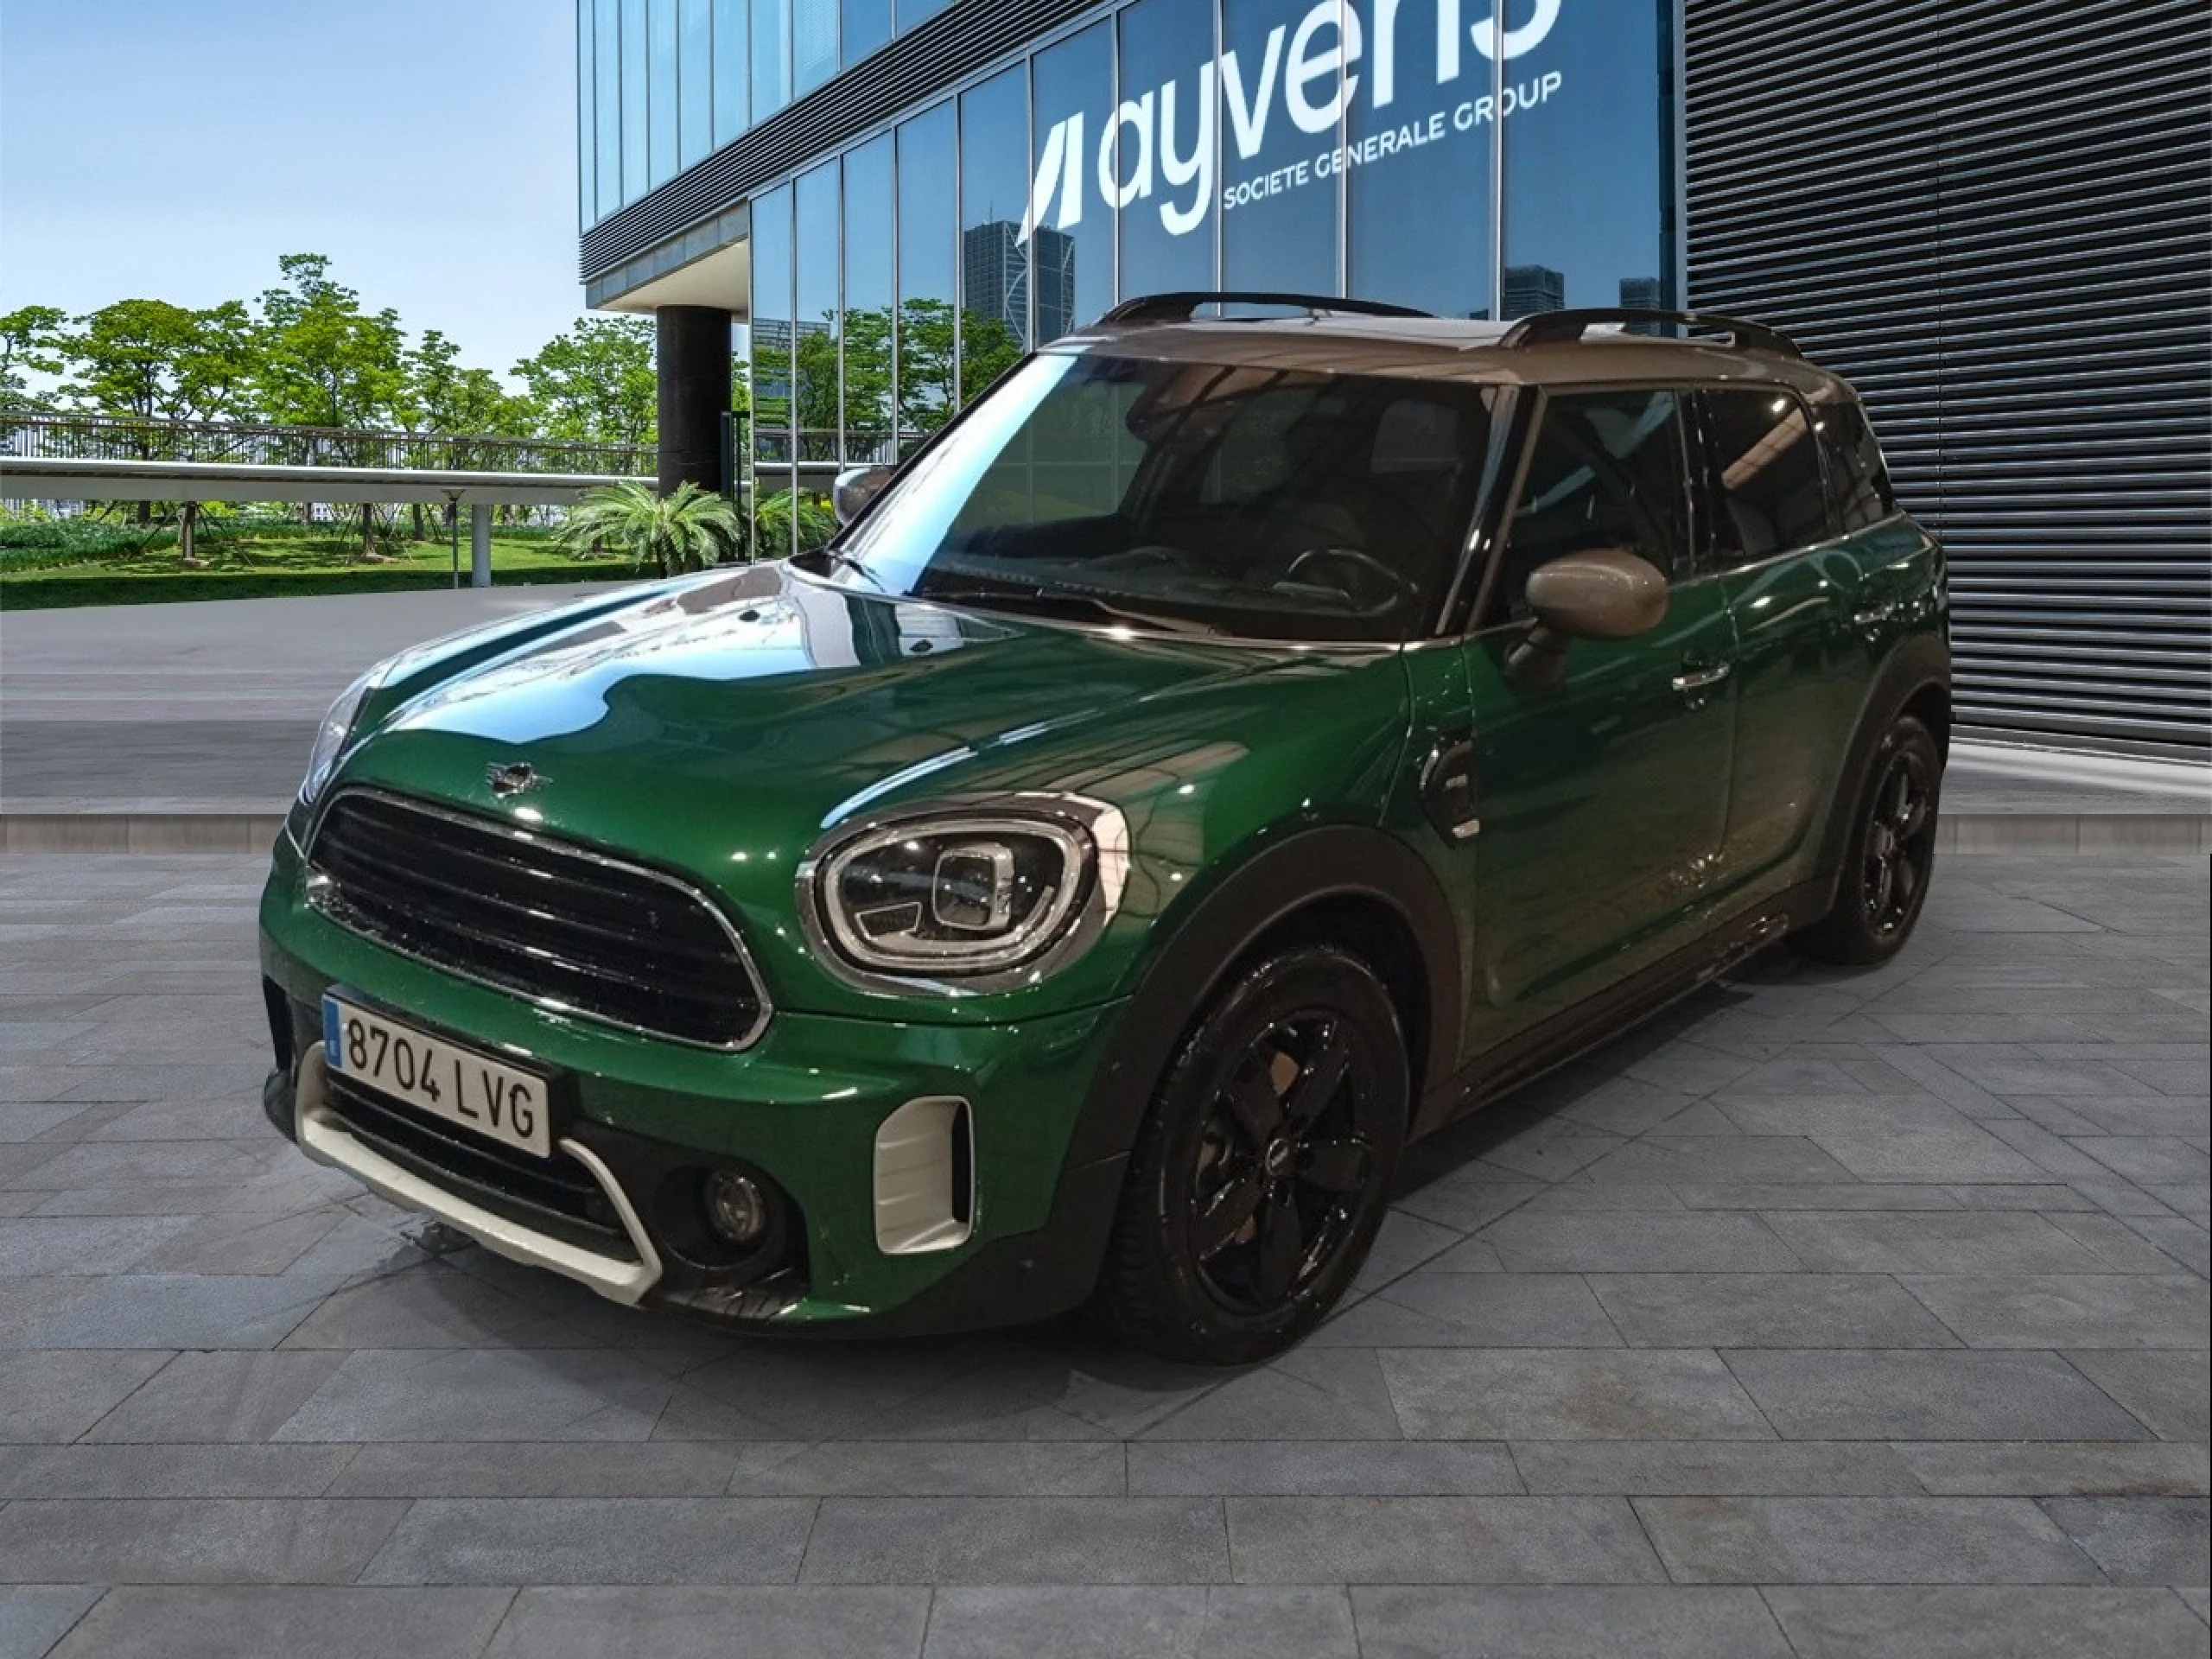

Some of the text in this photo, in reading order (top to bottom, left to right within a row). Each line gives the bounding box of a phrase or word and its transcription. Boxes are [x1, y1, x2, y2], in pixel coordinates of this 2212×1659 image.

[1223, 71, 1561, 210] SOCIETE GENERALE GROUP
[347, 1018, 442, 1103] 8704
[454, 1059, 534, 1140] LVG
